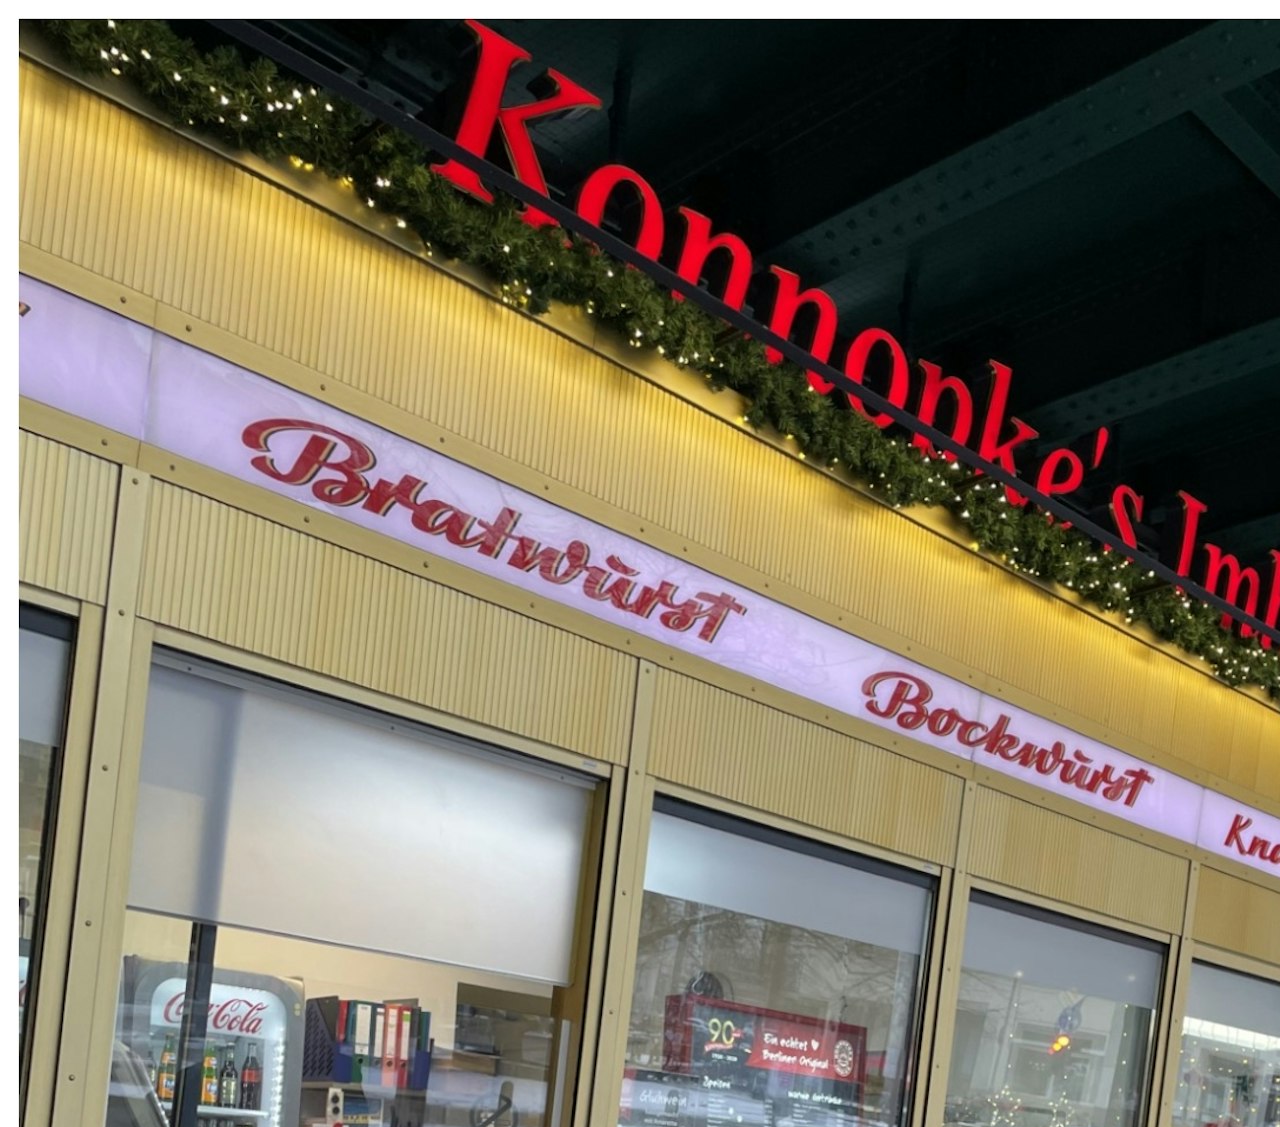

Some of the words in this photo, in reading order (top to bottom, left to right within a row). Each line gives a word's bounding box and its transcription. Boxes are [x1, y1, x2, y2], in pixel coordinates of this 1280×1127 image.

[430, 19, 1144, 563] Konnopke's
[708, 1018, 735, 1045] 90
[763, 1033, 778, 1046] Ein
[780, 1036, 808, 1051] echtes
[762, 1049, 798, 1064] Berliner
[799, 1055, 829, 1073] Original
